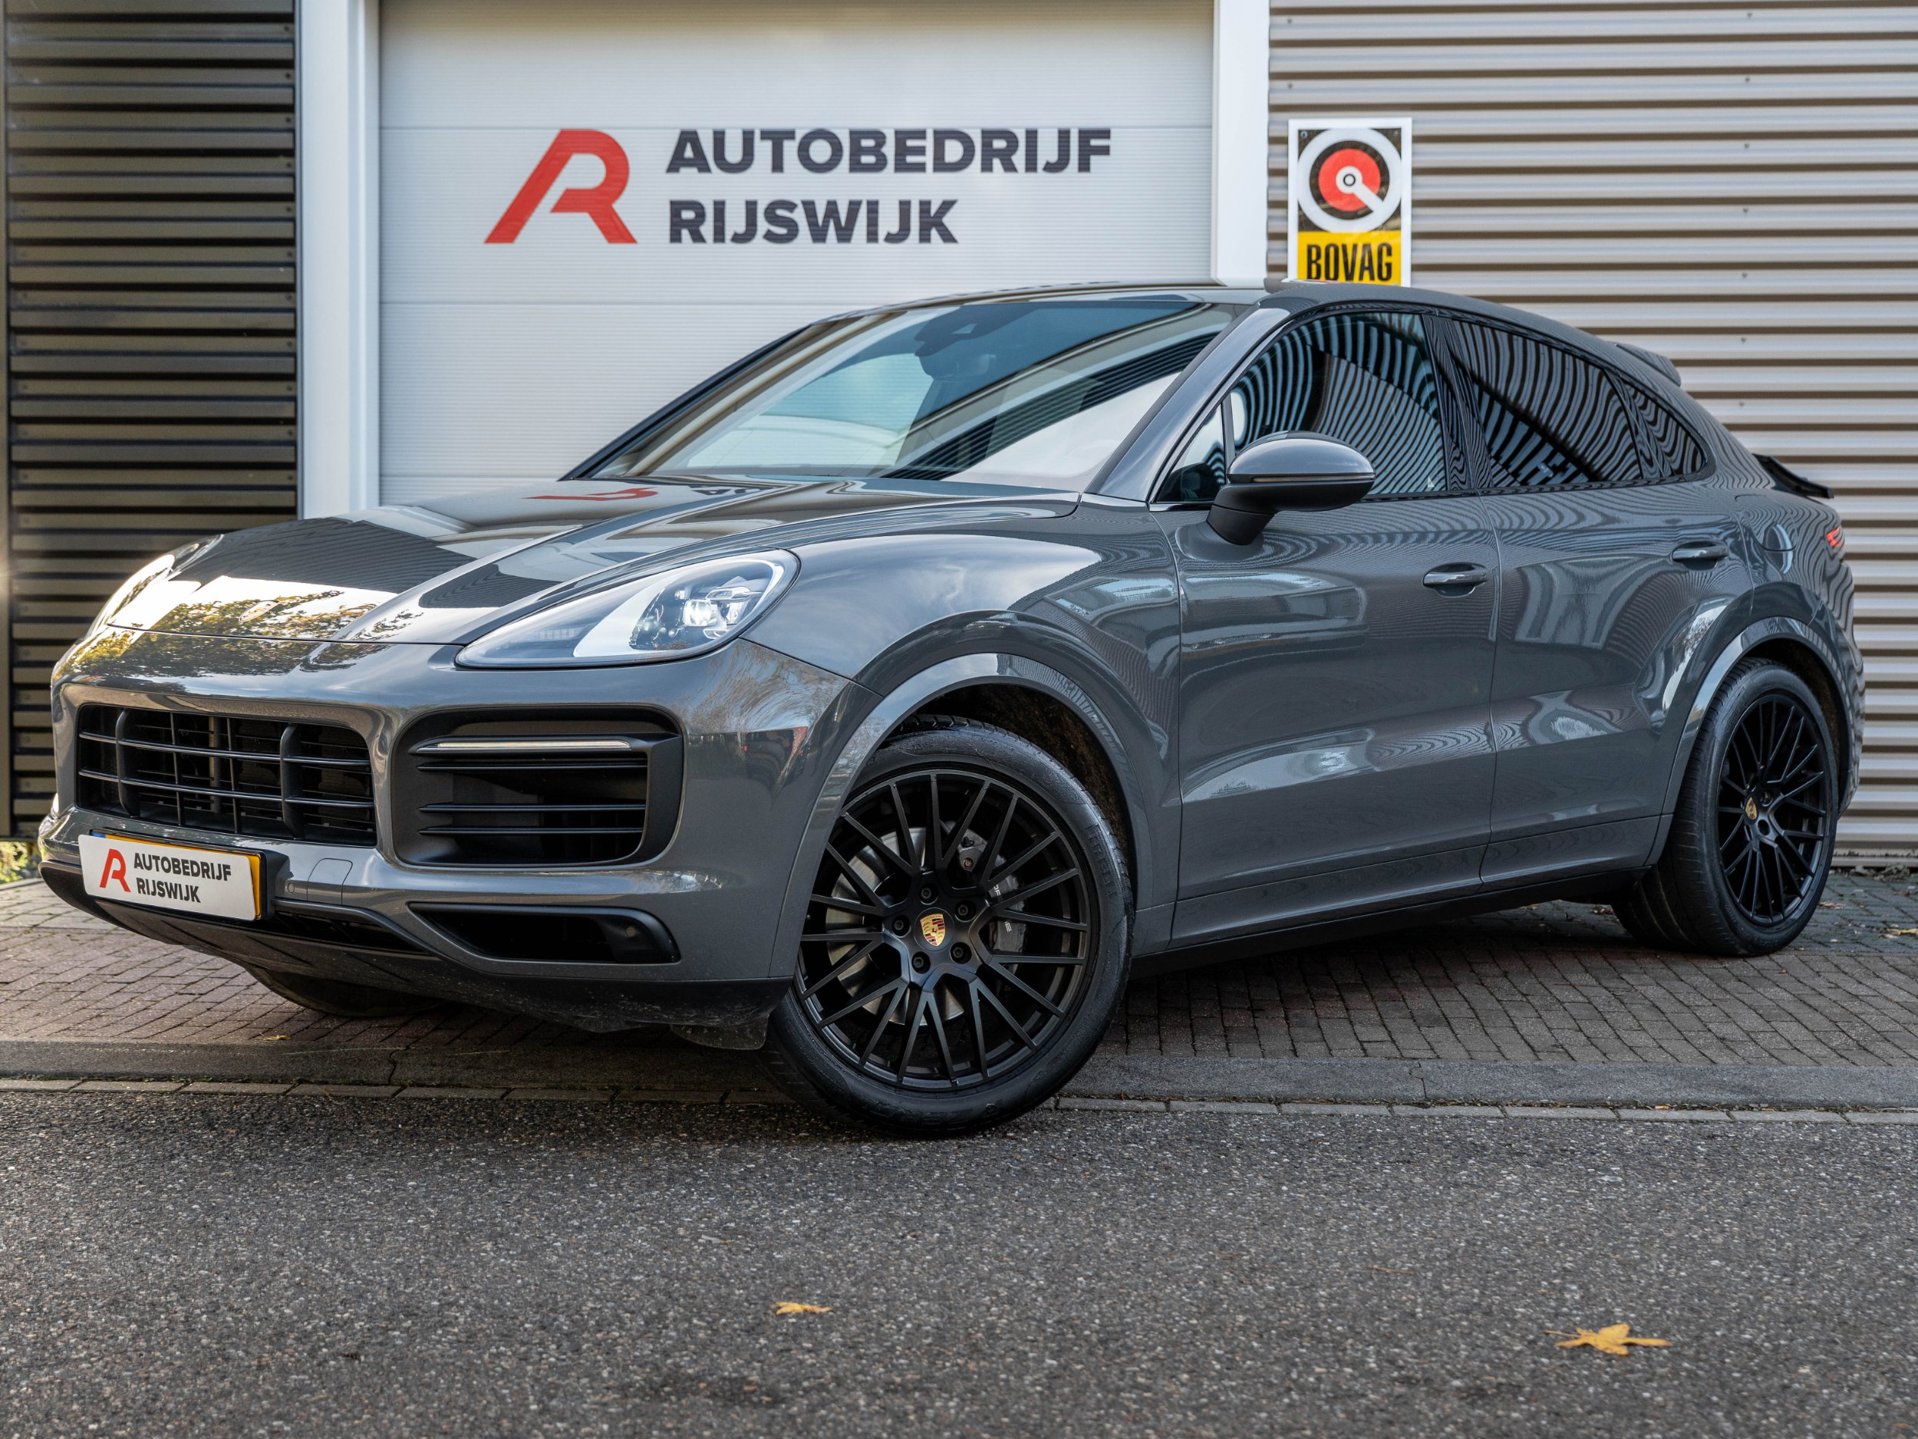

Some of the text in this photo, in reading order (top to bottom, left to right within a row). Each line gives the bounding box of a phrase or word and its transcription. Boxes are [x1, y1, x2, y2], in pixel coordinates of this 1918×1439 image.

[665, 128, 1112, 174] AUTOBEDRIJF
[669, 199, 959, 244] RIJSWIJK
[1306, 242, 1393, 282] BOVAG
[133, 852, 232, 882] AUTOBEDRIJF
[136, 877, 201, 904] RIJSWIJK
